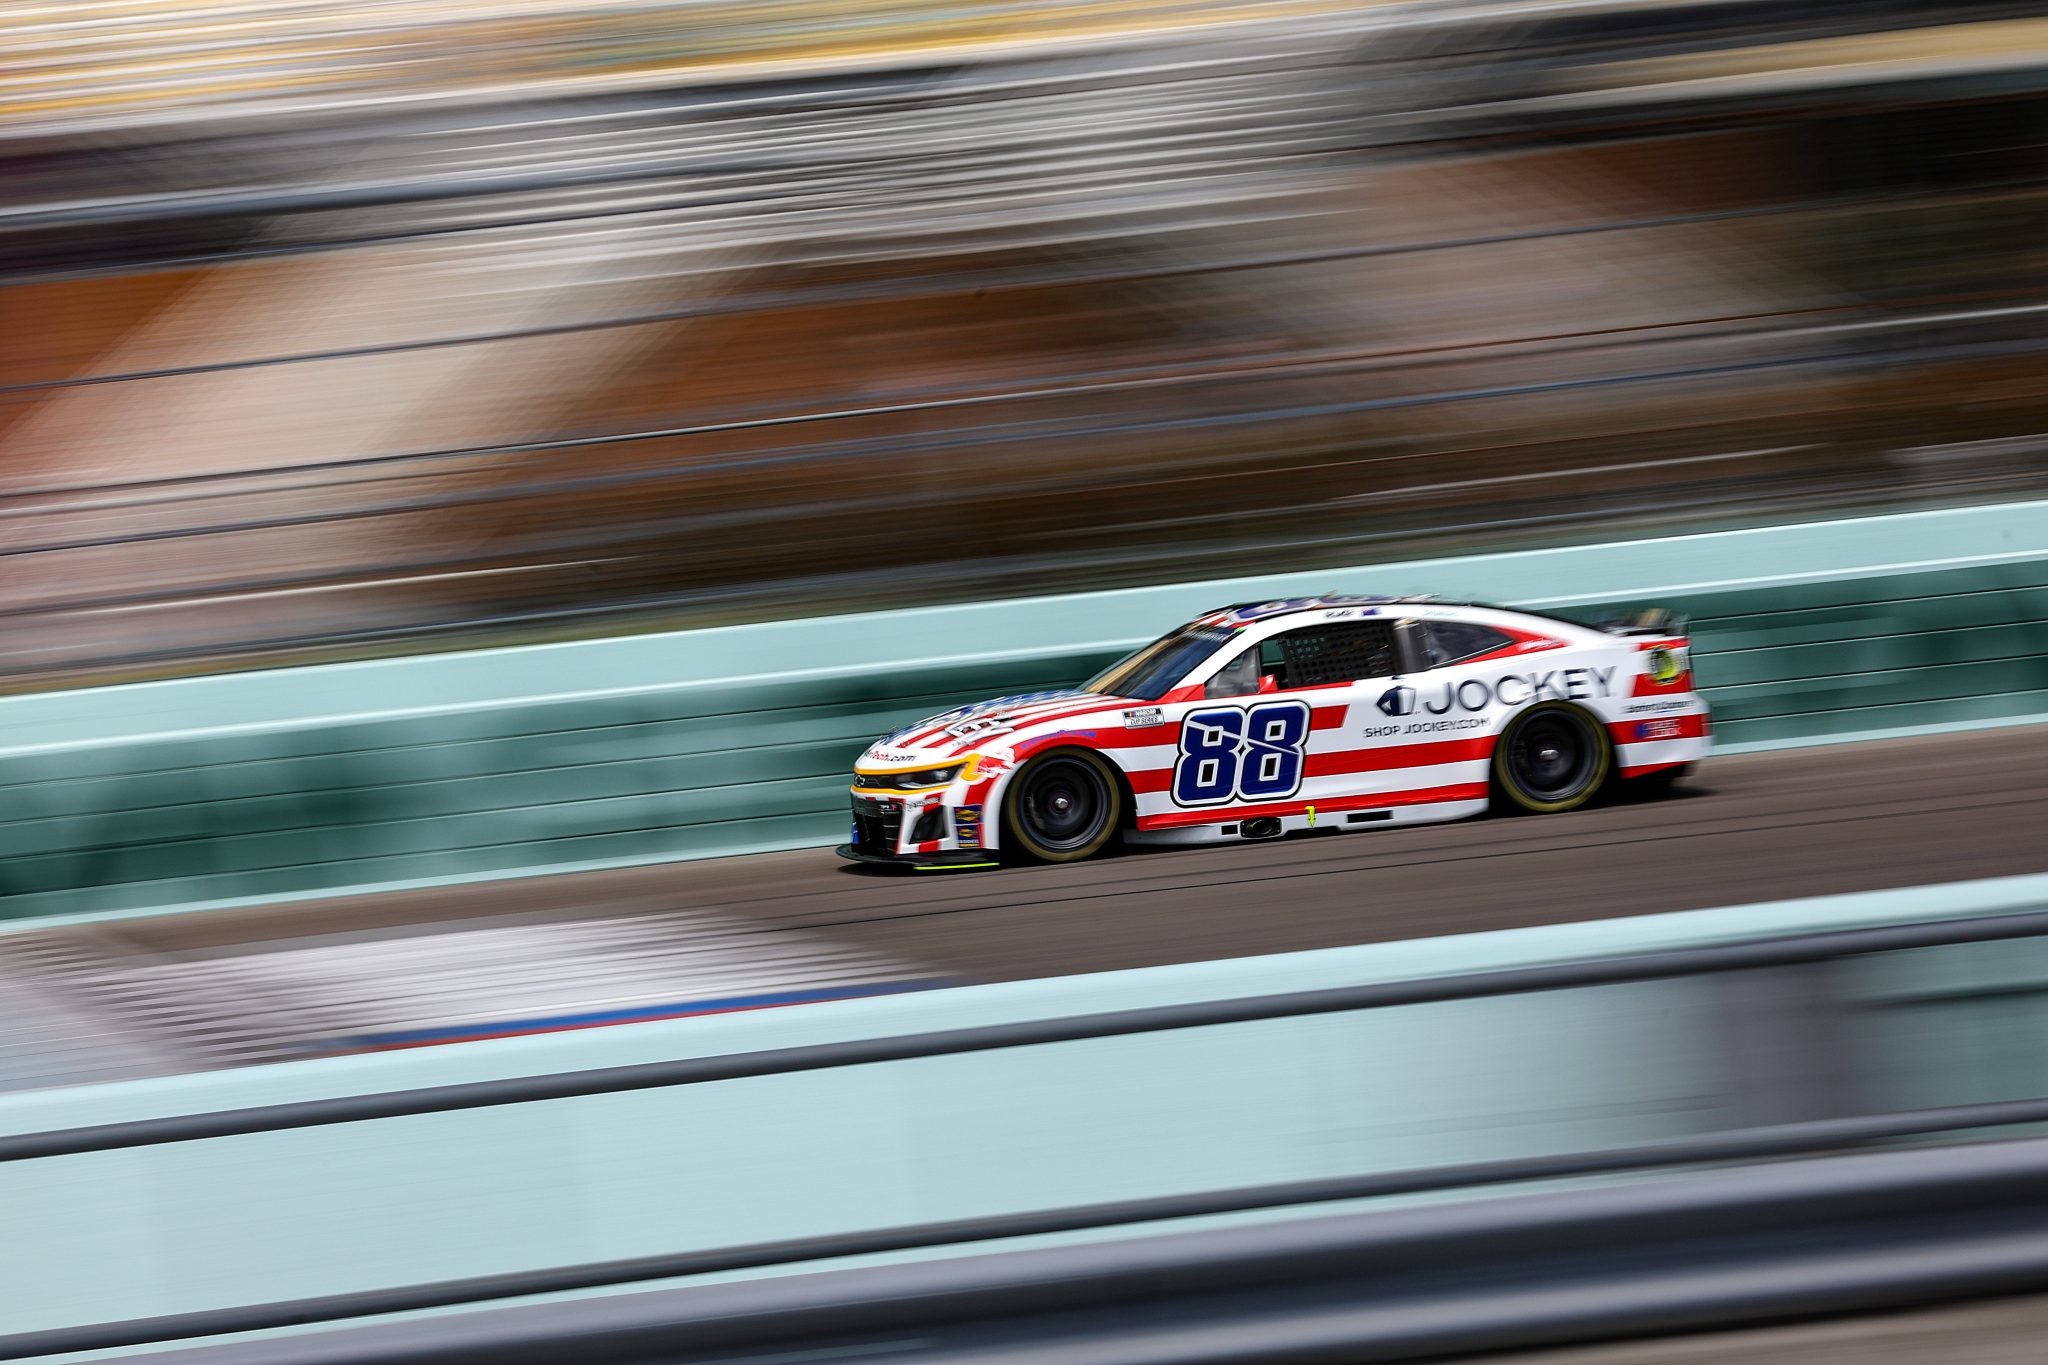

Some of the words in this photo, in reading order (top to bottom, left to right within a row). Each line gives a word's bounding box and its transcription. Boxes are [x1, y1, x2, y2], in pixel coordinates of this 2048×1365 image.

[1424, 666, 1617, 715] JOCKEY
[1364, 725, 1401, 738] SHOP
[1403, 718, 1492, 734] JOCKEY.COM
[1170, 700, 1311, 808] 88
